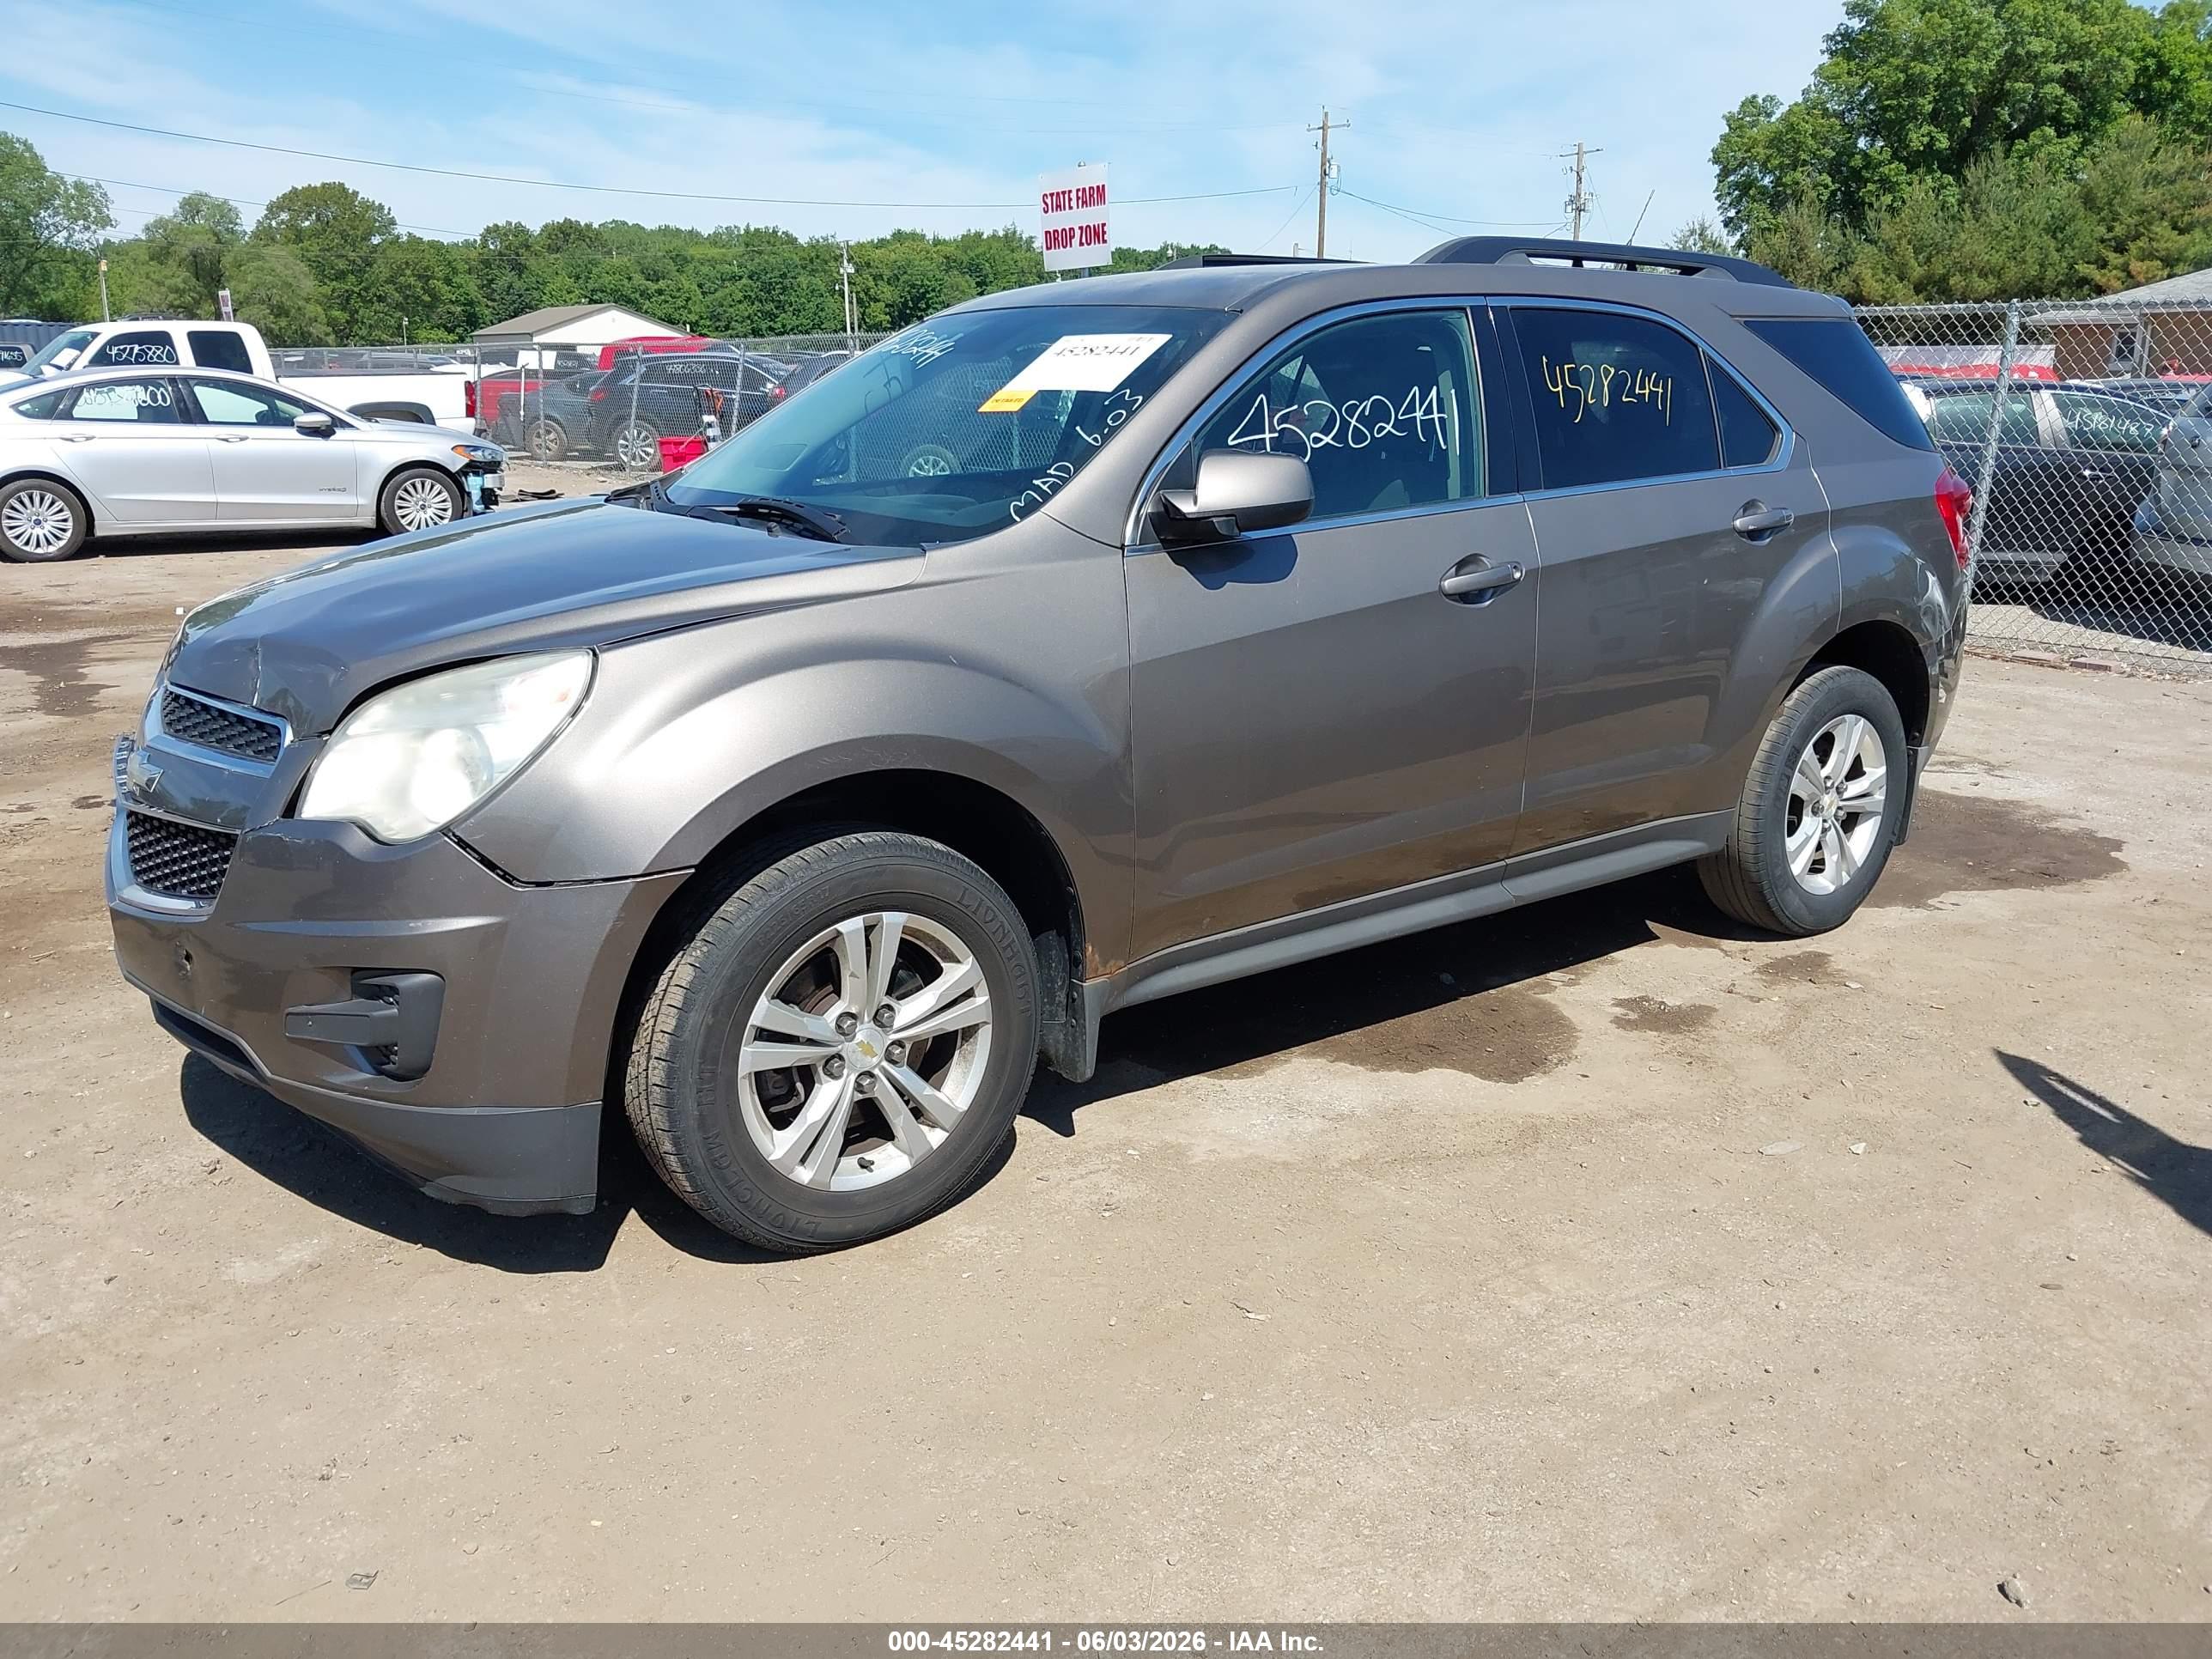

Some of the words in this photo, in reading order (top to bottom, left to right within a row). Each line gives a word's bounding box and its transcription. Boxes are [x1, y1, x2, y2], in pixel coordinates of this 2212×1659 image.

[1042, 190, 1073, 214] STATE
[1076, 184, 1106, 209] FARM
[1044, 227, 1075, 251] DROP
[1079, 222, 1108, 246] ZONE
[106, 344, 176, 363] 45275880
[1542, 355, 1672, 426] 45282441
[1228, 386, 1461, 463] 45282441
[1010, 462, 1074, 521] MAD
